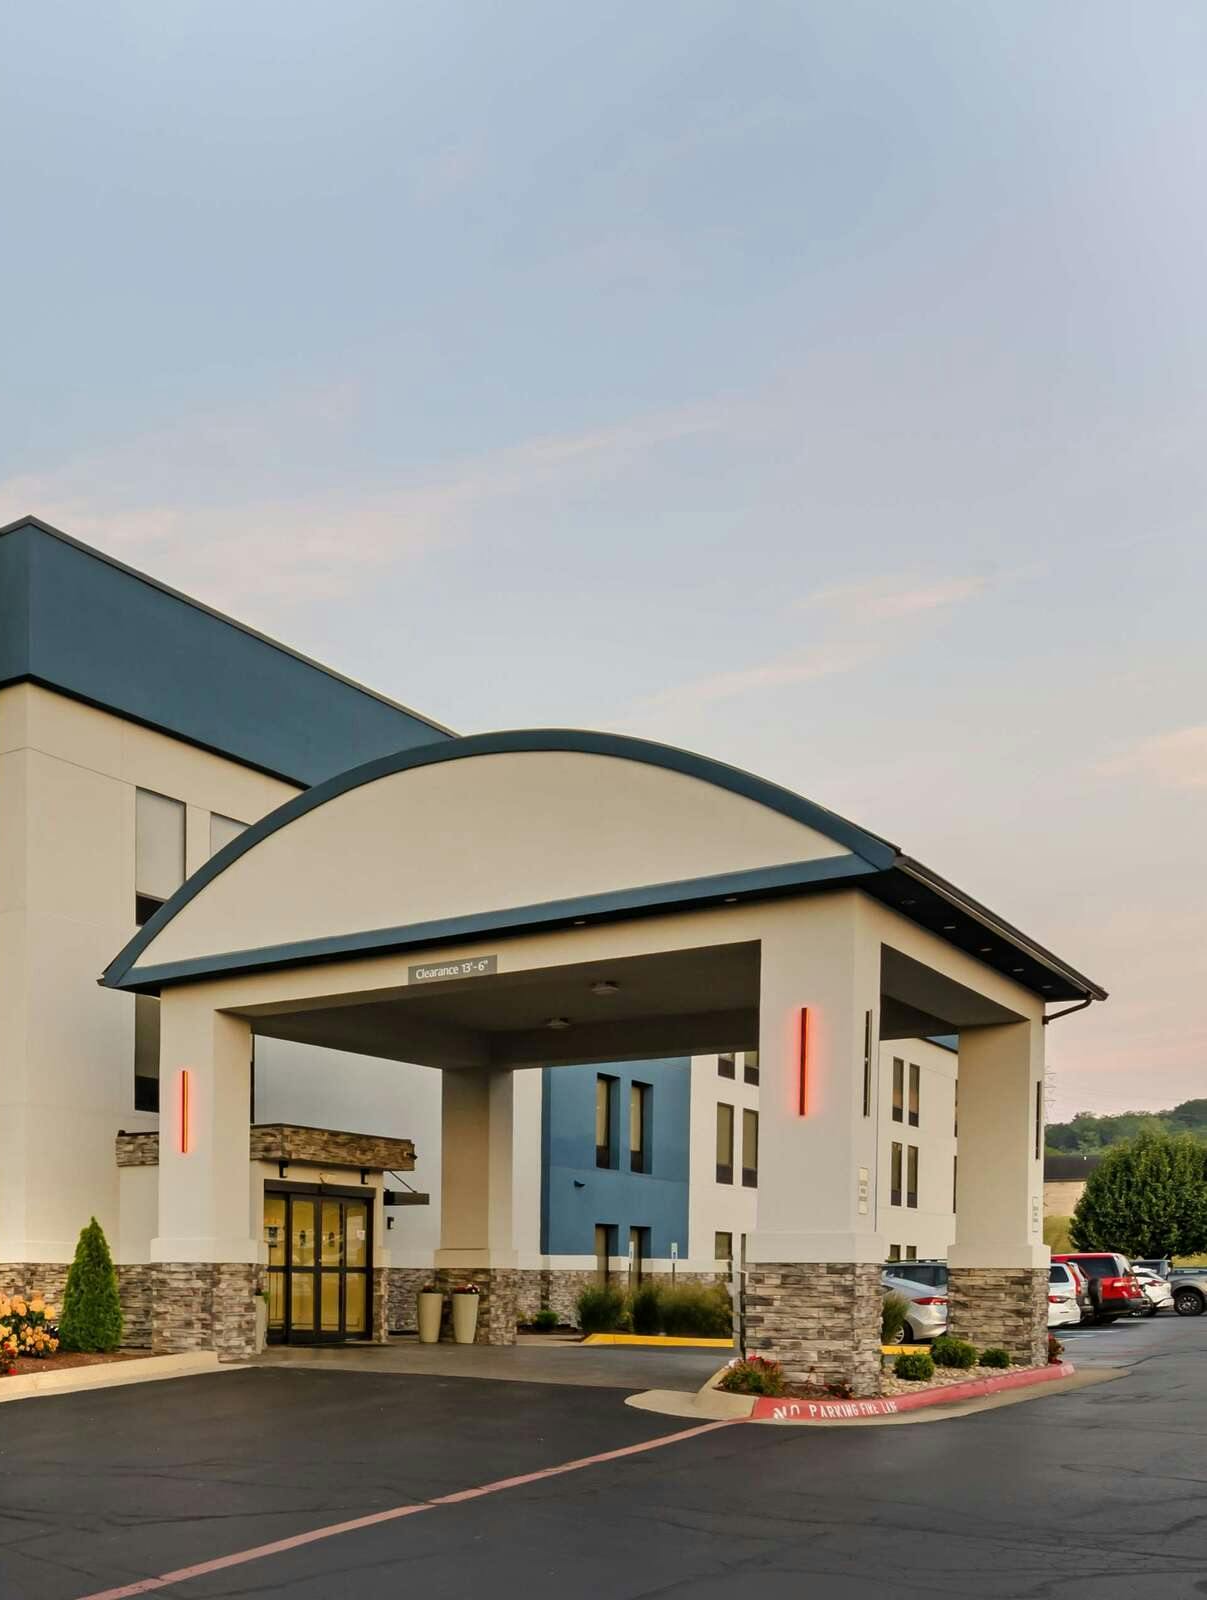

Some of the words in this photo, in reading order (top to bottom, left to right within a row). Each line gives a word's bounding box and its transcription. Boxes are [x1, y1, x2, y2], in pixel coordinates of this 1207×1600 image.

[415, 966, 459, 979] Clearance
[773, 1404, 800, 1419] NO
[808, 1403, 859, 1418] PARKING
